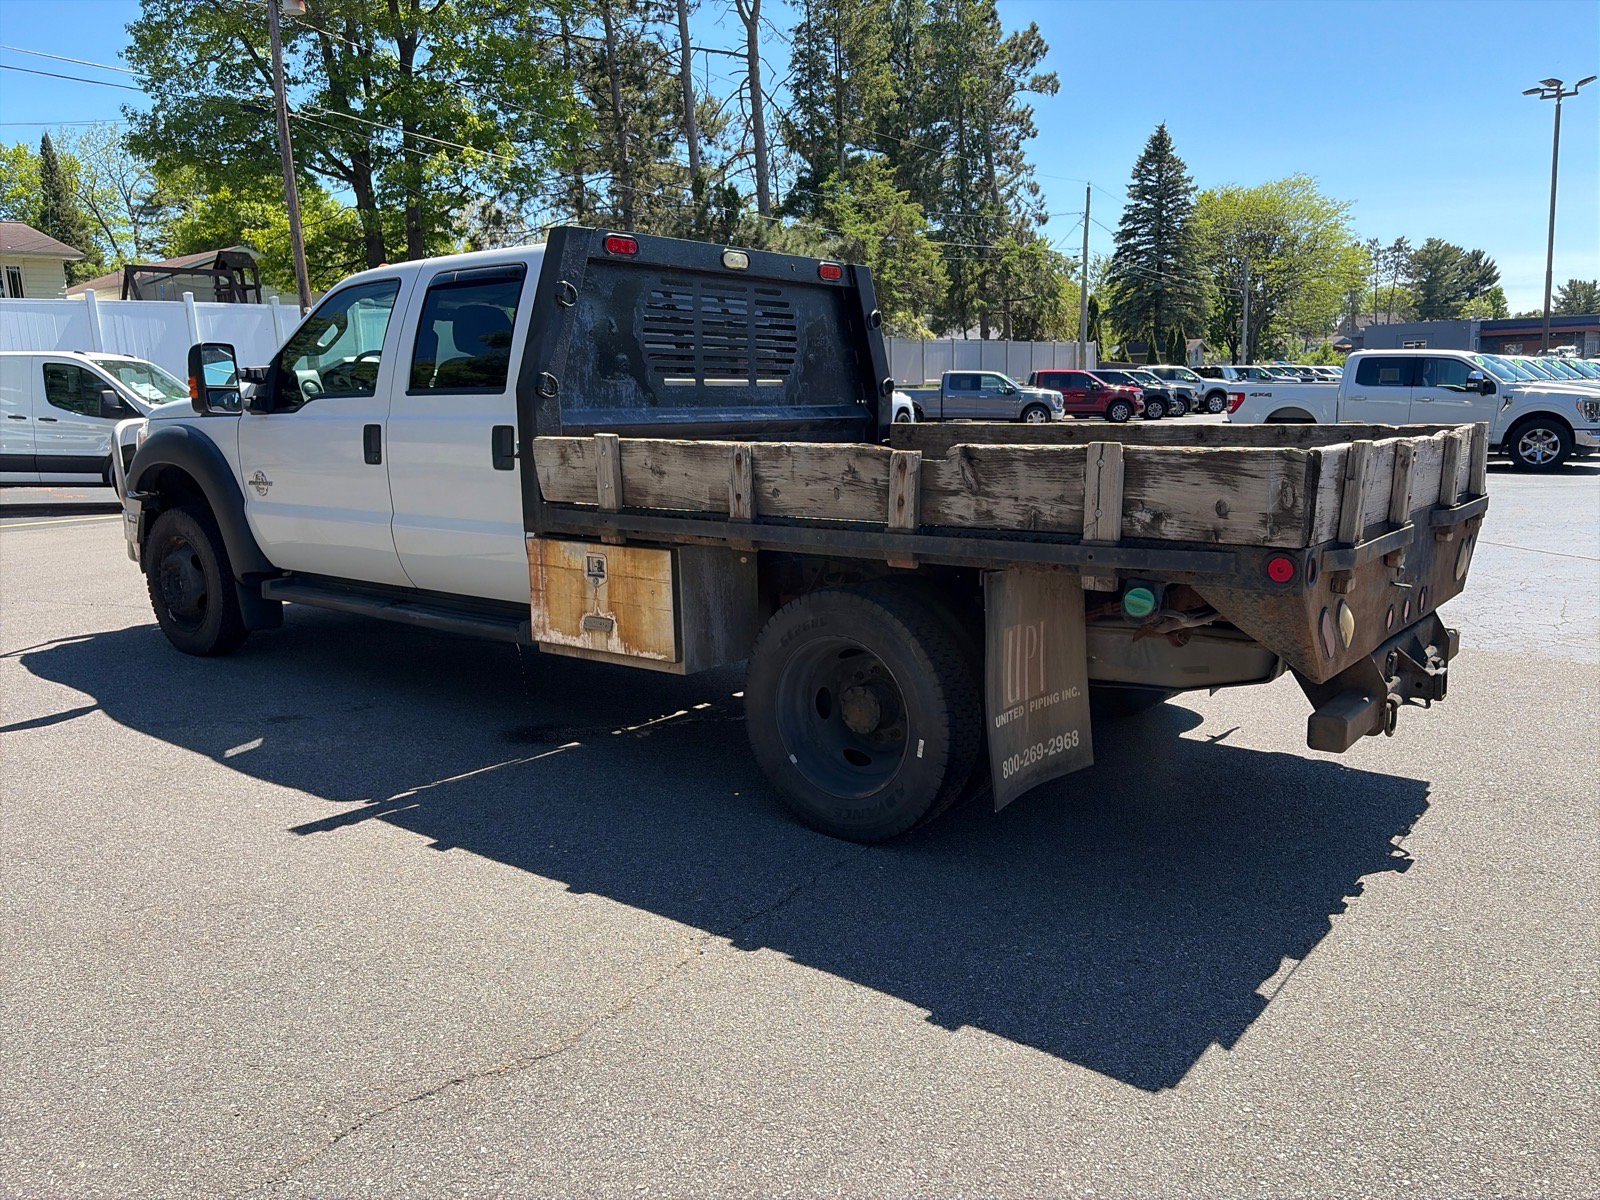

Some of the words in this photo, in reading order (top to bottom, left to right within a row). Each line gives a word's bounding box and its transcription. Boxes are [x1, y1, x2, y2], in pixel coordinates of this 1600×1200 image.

[1006, 621, 1045, 703] UPI
[995, 705, 1025, 728] UNITED
[1029, 692, 1060, 713] PIPING
[1061, 686, 1081, 701] INC.
[1002, 730, 1079, 779] 800-269-2968
